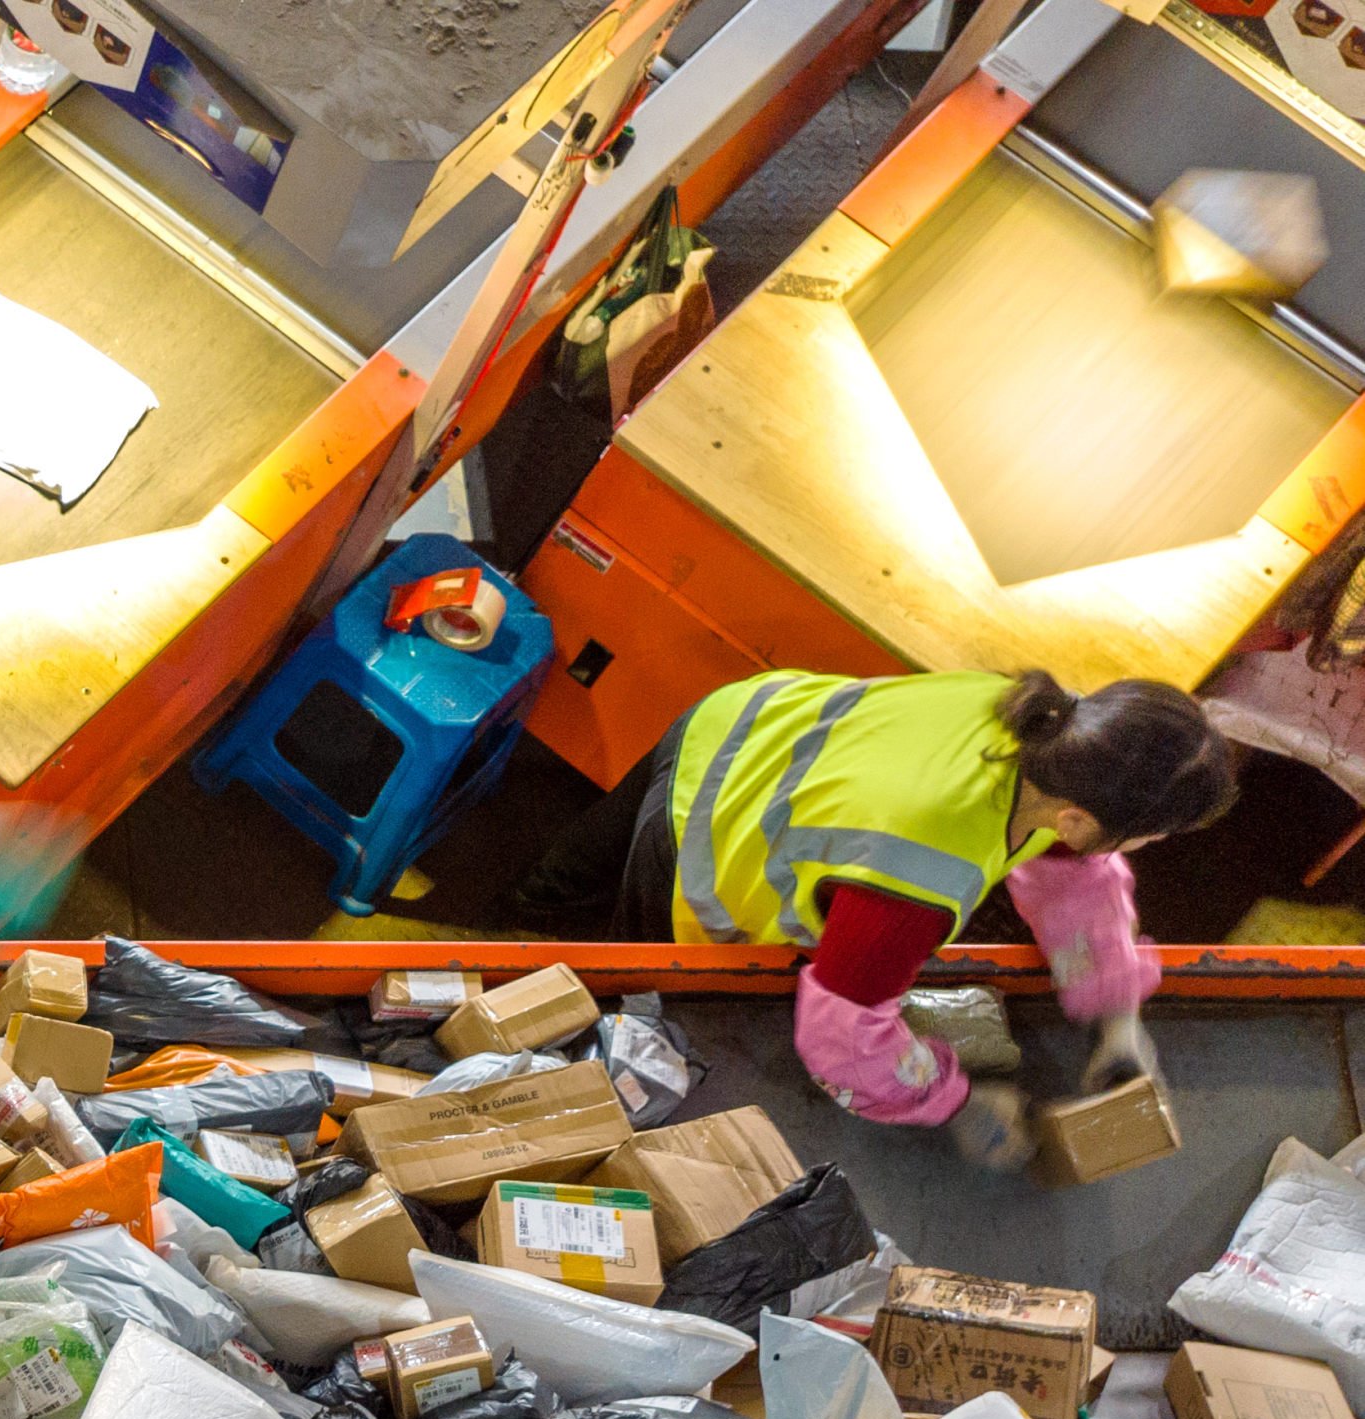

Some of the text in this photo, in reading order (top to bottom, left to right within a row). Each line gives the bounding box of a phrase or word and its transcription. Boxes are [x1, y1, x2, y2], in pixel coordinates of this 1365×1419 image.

[429, 1089, 540, 1124] PROCTER & GAMBLE
